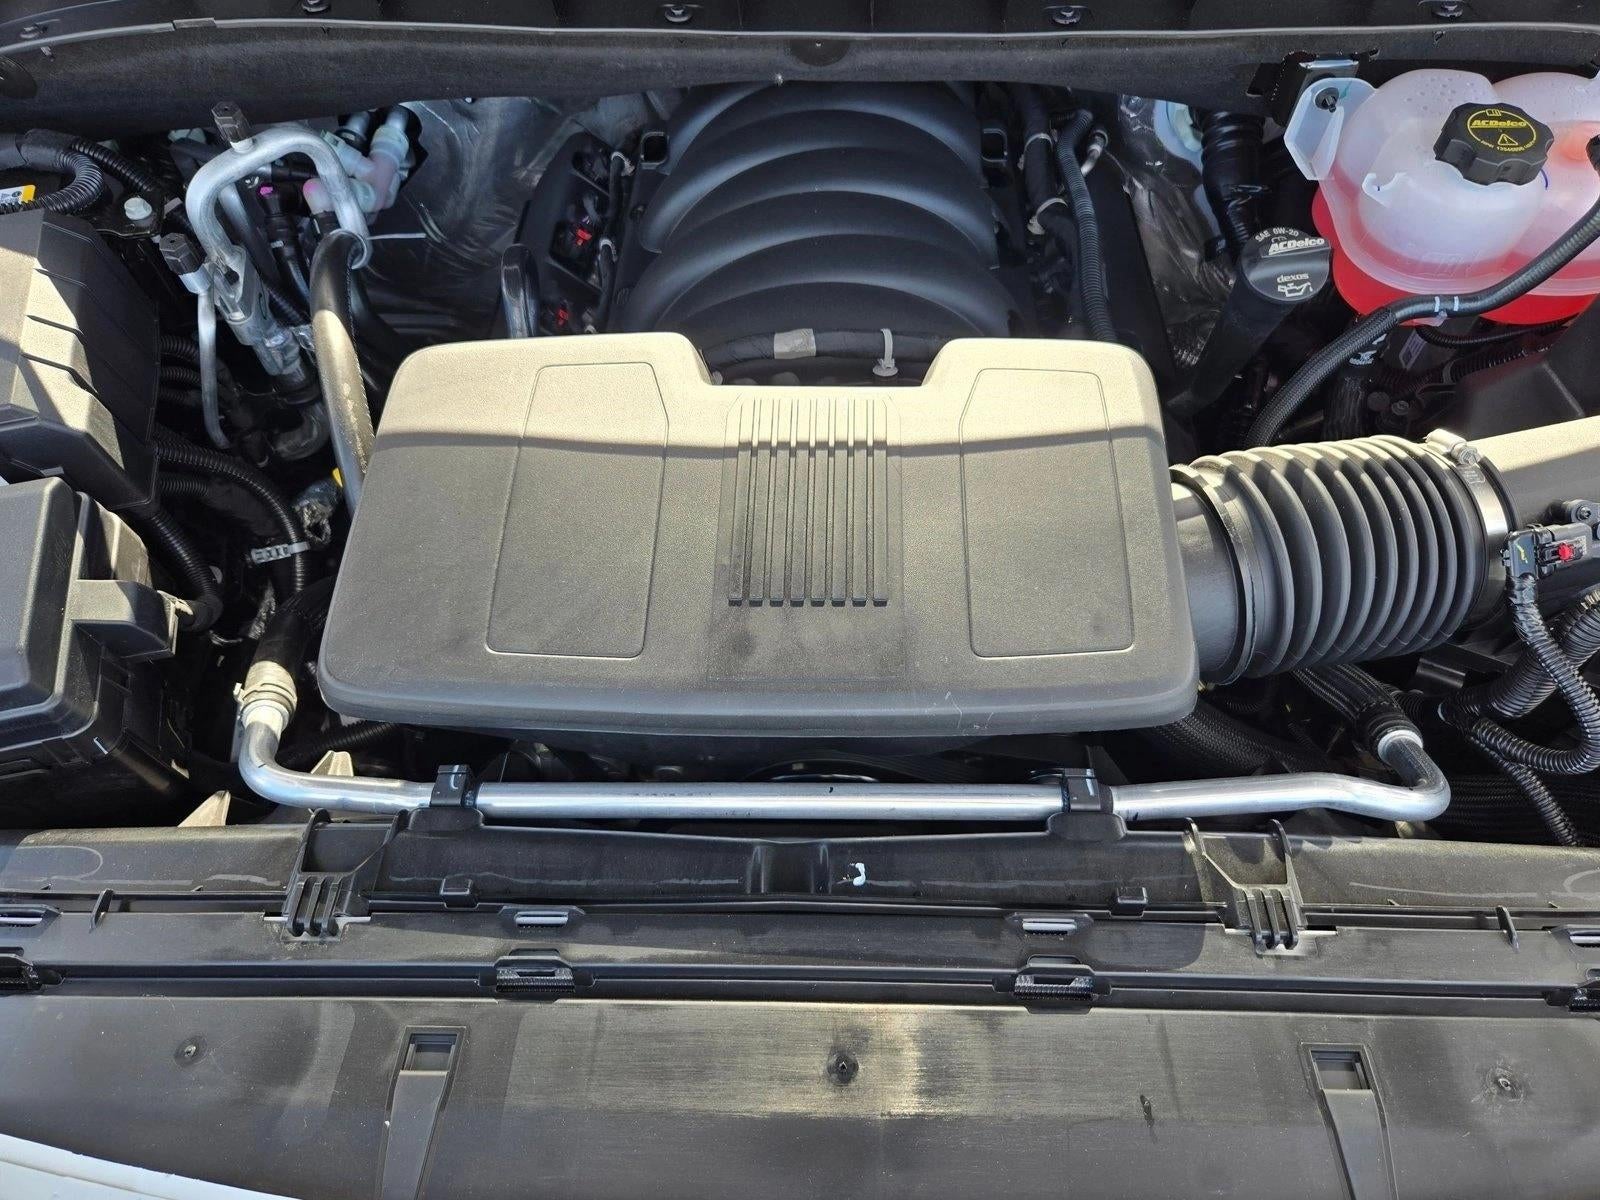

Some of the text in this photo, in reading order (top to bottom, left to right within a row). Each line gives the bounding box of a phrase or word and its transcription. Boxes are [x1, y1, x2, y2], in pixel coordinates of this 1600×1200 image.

[1470, 119, 1527, 128] ACDelco
[1255, 227, 1299, 242] SAE 0W-20
[1268, 238, 1325, 256] ACDelco
[1277, 273, 1309, 283] dexos
